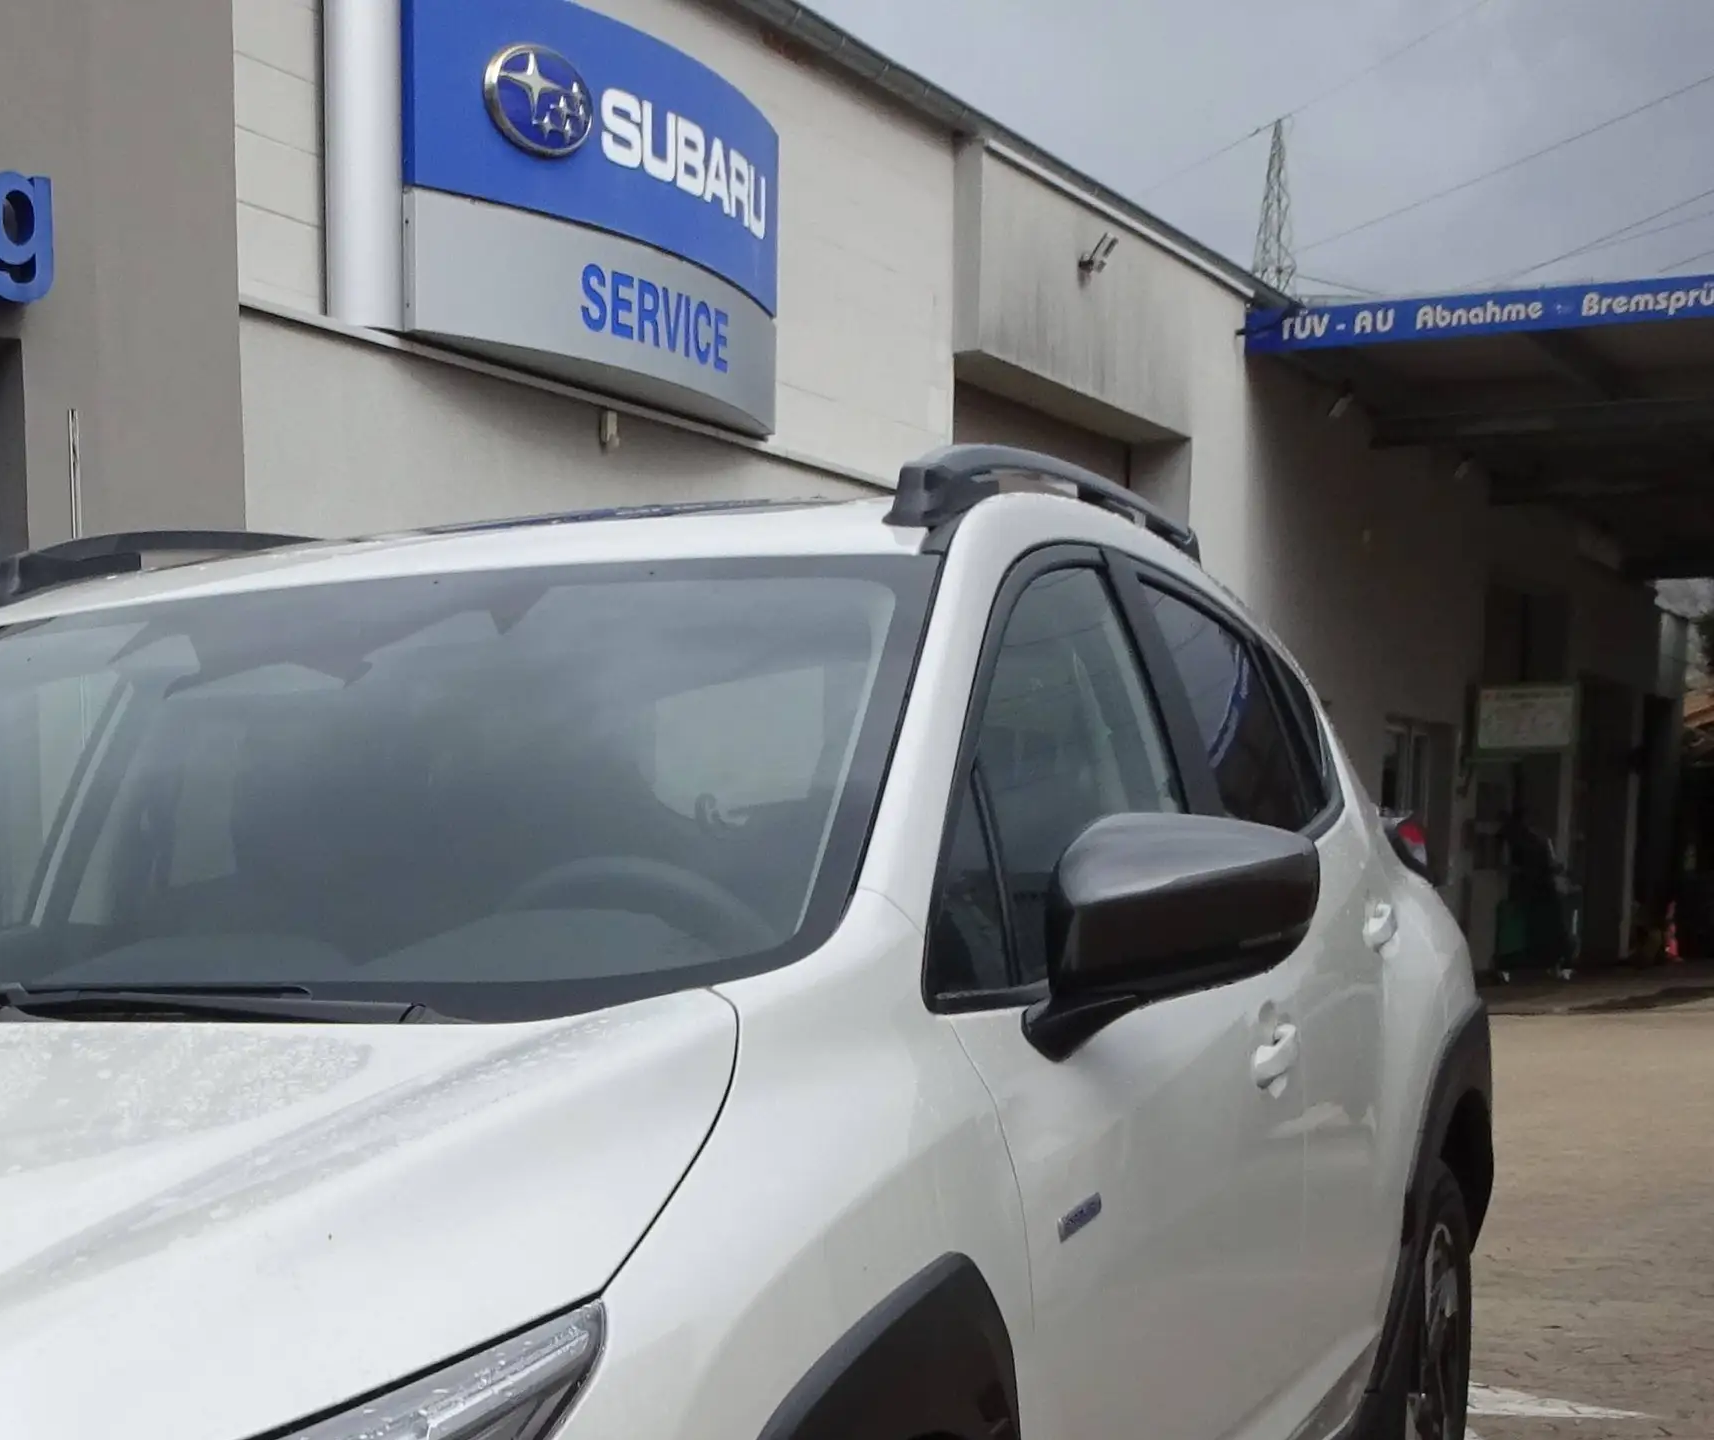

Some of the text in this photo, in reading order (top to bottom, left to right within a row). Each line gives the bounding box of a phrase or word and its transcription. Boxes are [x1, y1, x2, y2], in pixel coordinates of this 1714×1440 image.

[601, 88, 766, 240] SUBARU
[581, 263, 728, 374] SERVICE
[1282, 310, 1330, 341] TÜV
[1354, 308, 1395, 335] AU
[1415, 300, 1543, 331] Abnahme
